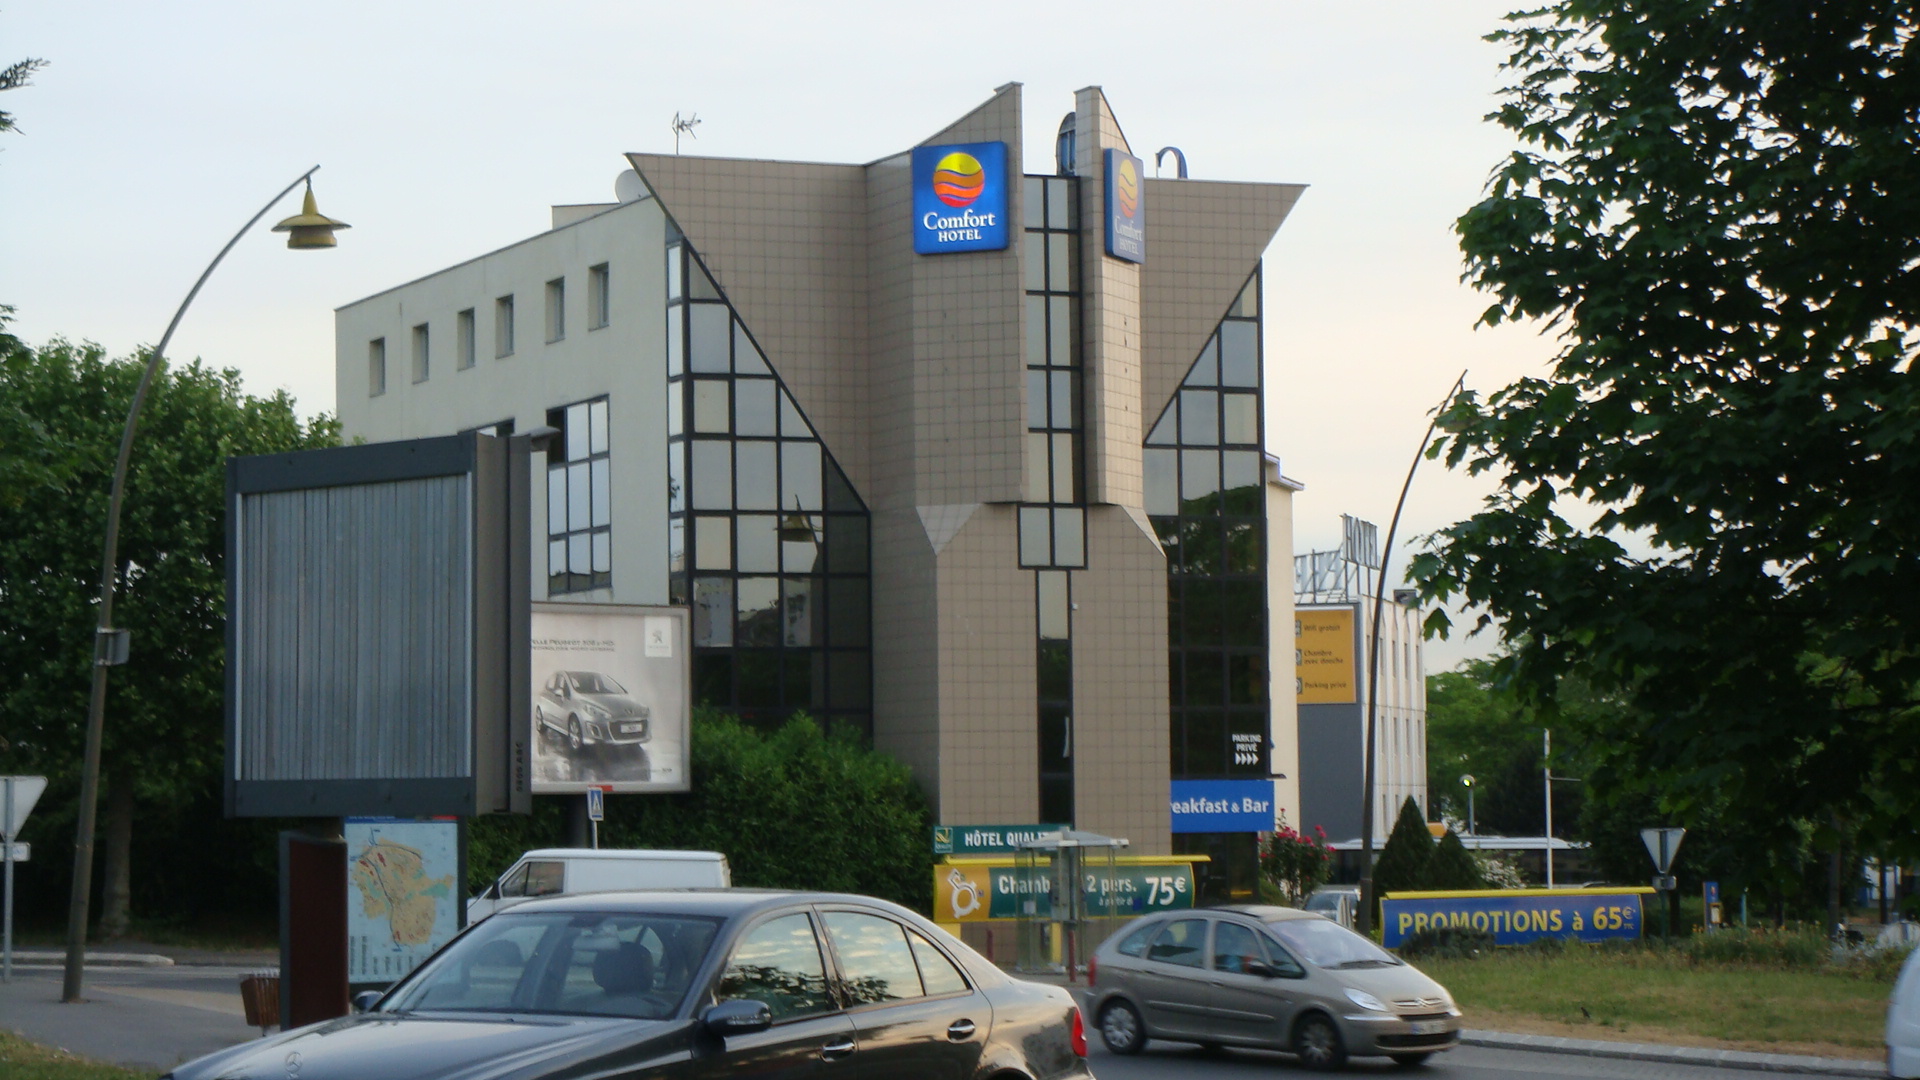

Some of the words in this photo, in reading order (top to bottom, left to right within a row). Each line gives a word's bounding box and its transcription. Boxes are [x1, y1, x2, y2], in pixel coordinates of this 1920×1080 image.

[923, 209, 996, 231] Comfort
[1115, 215, 1143, 241] Comfort
[938, 229, 982, 242] HOTEL
[1119, 238, 1139, 255] HOTEL
[1232, 733, 1262, 743] PARKING
[1170, 797, 1229, 814] eakfast
[1231, 802, 1240, 814] &
[1243, 797, 1269, 813] Bar
[964, 829, 1004, 847] HÔTEL
[998, 875, 1051, 894] Chamb
[1086, 875, 1097, 892] 2
[1398, 909, 1563, 936] PROMOTIONS
[1572, 911, 1584, 931] à
